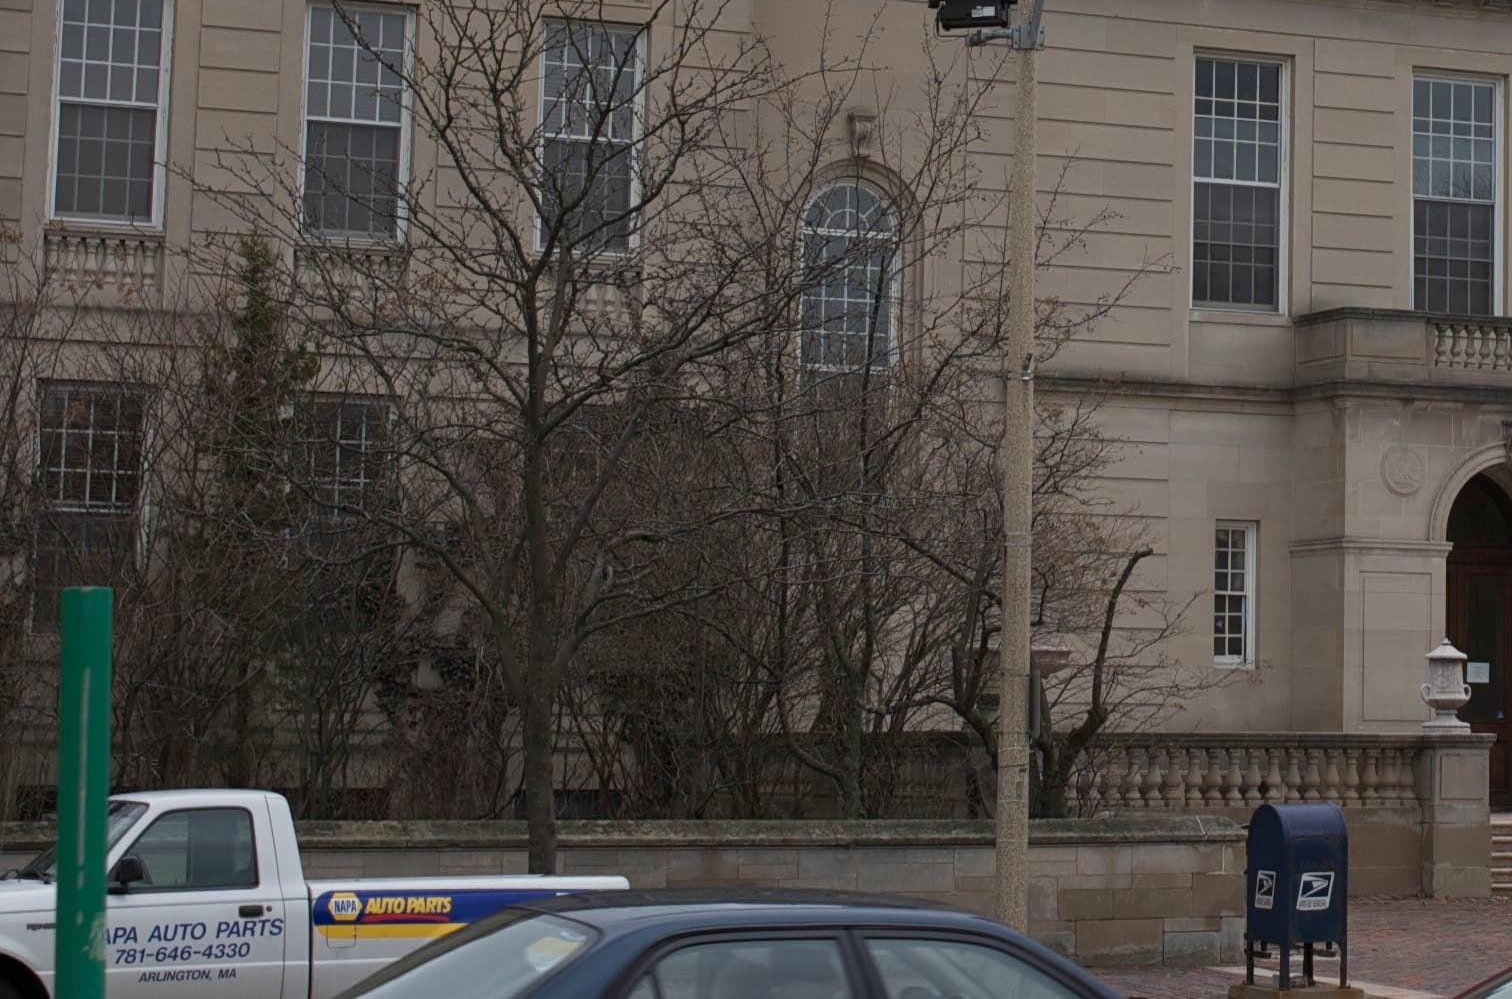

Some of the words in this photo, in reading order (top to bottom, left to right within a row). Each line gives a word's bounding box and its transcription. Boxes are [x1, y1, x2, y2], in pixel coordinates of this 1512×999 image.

[334, 898, 358, 914] NAPA
[365, 897, 406, 914] AUTO
[406, 896, 452, 913] PARTS
[148, 921, 207, 943] AUTO
[215, 918, 284, 939] PARTS
[114, 942, 251, 965] 781-646-4330
[138, 969, 213, 983] ARLINGTON,
[217, 968, 237, 979] MA
